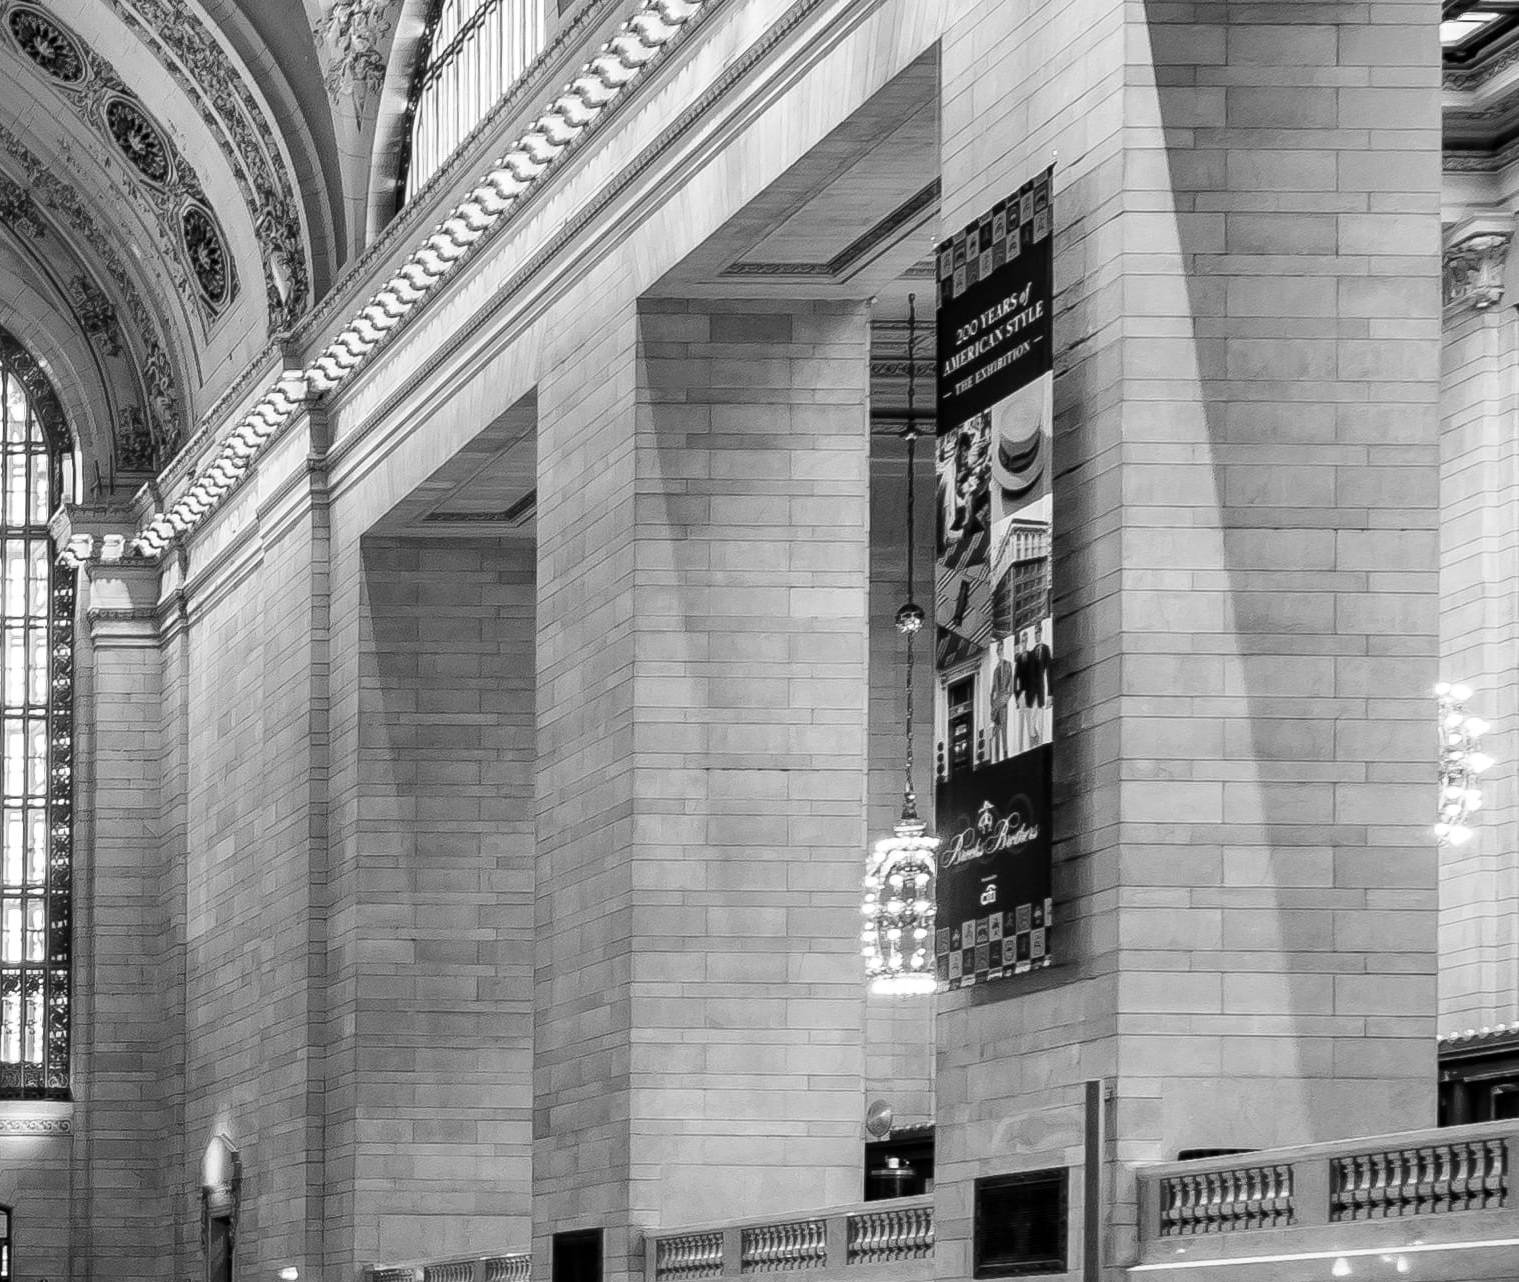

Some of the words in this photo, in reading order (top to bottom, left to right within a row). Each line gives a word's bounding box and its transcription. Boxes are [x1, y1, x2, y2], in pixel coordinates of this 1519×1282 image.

[943, 325, 1004, 377] AMERICAN
[1006, 300, 1044, 337] STYLE
[956, 319, 978, 346] 200
[980, 292, 1018, 329] YEARS
[1019, 281, 1033, 306] of
[955, 375, 973, 396] THE
[975, 339, 1030, 384] EXHIBITION
